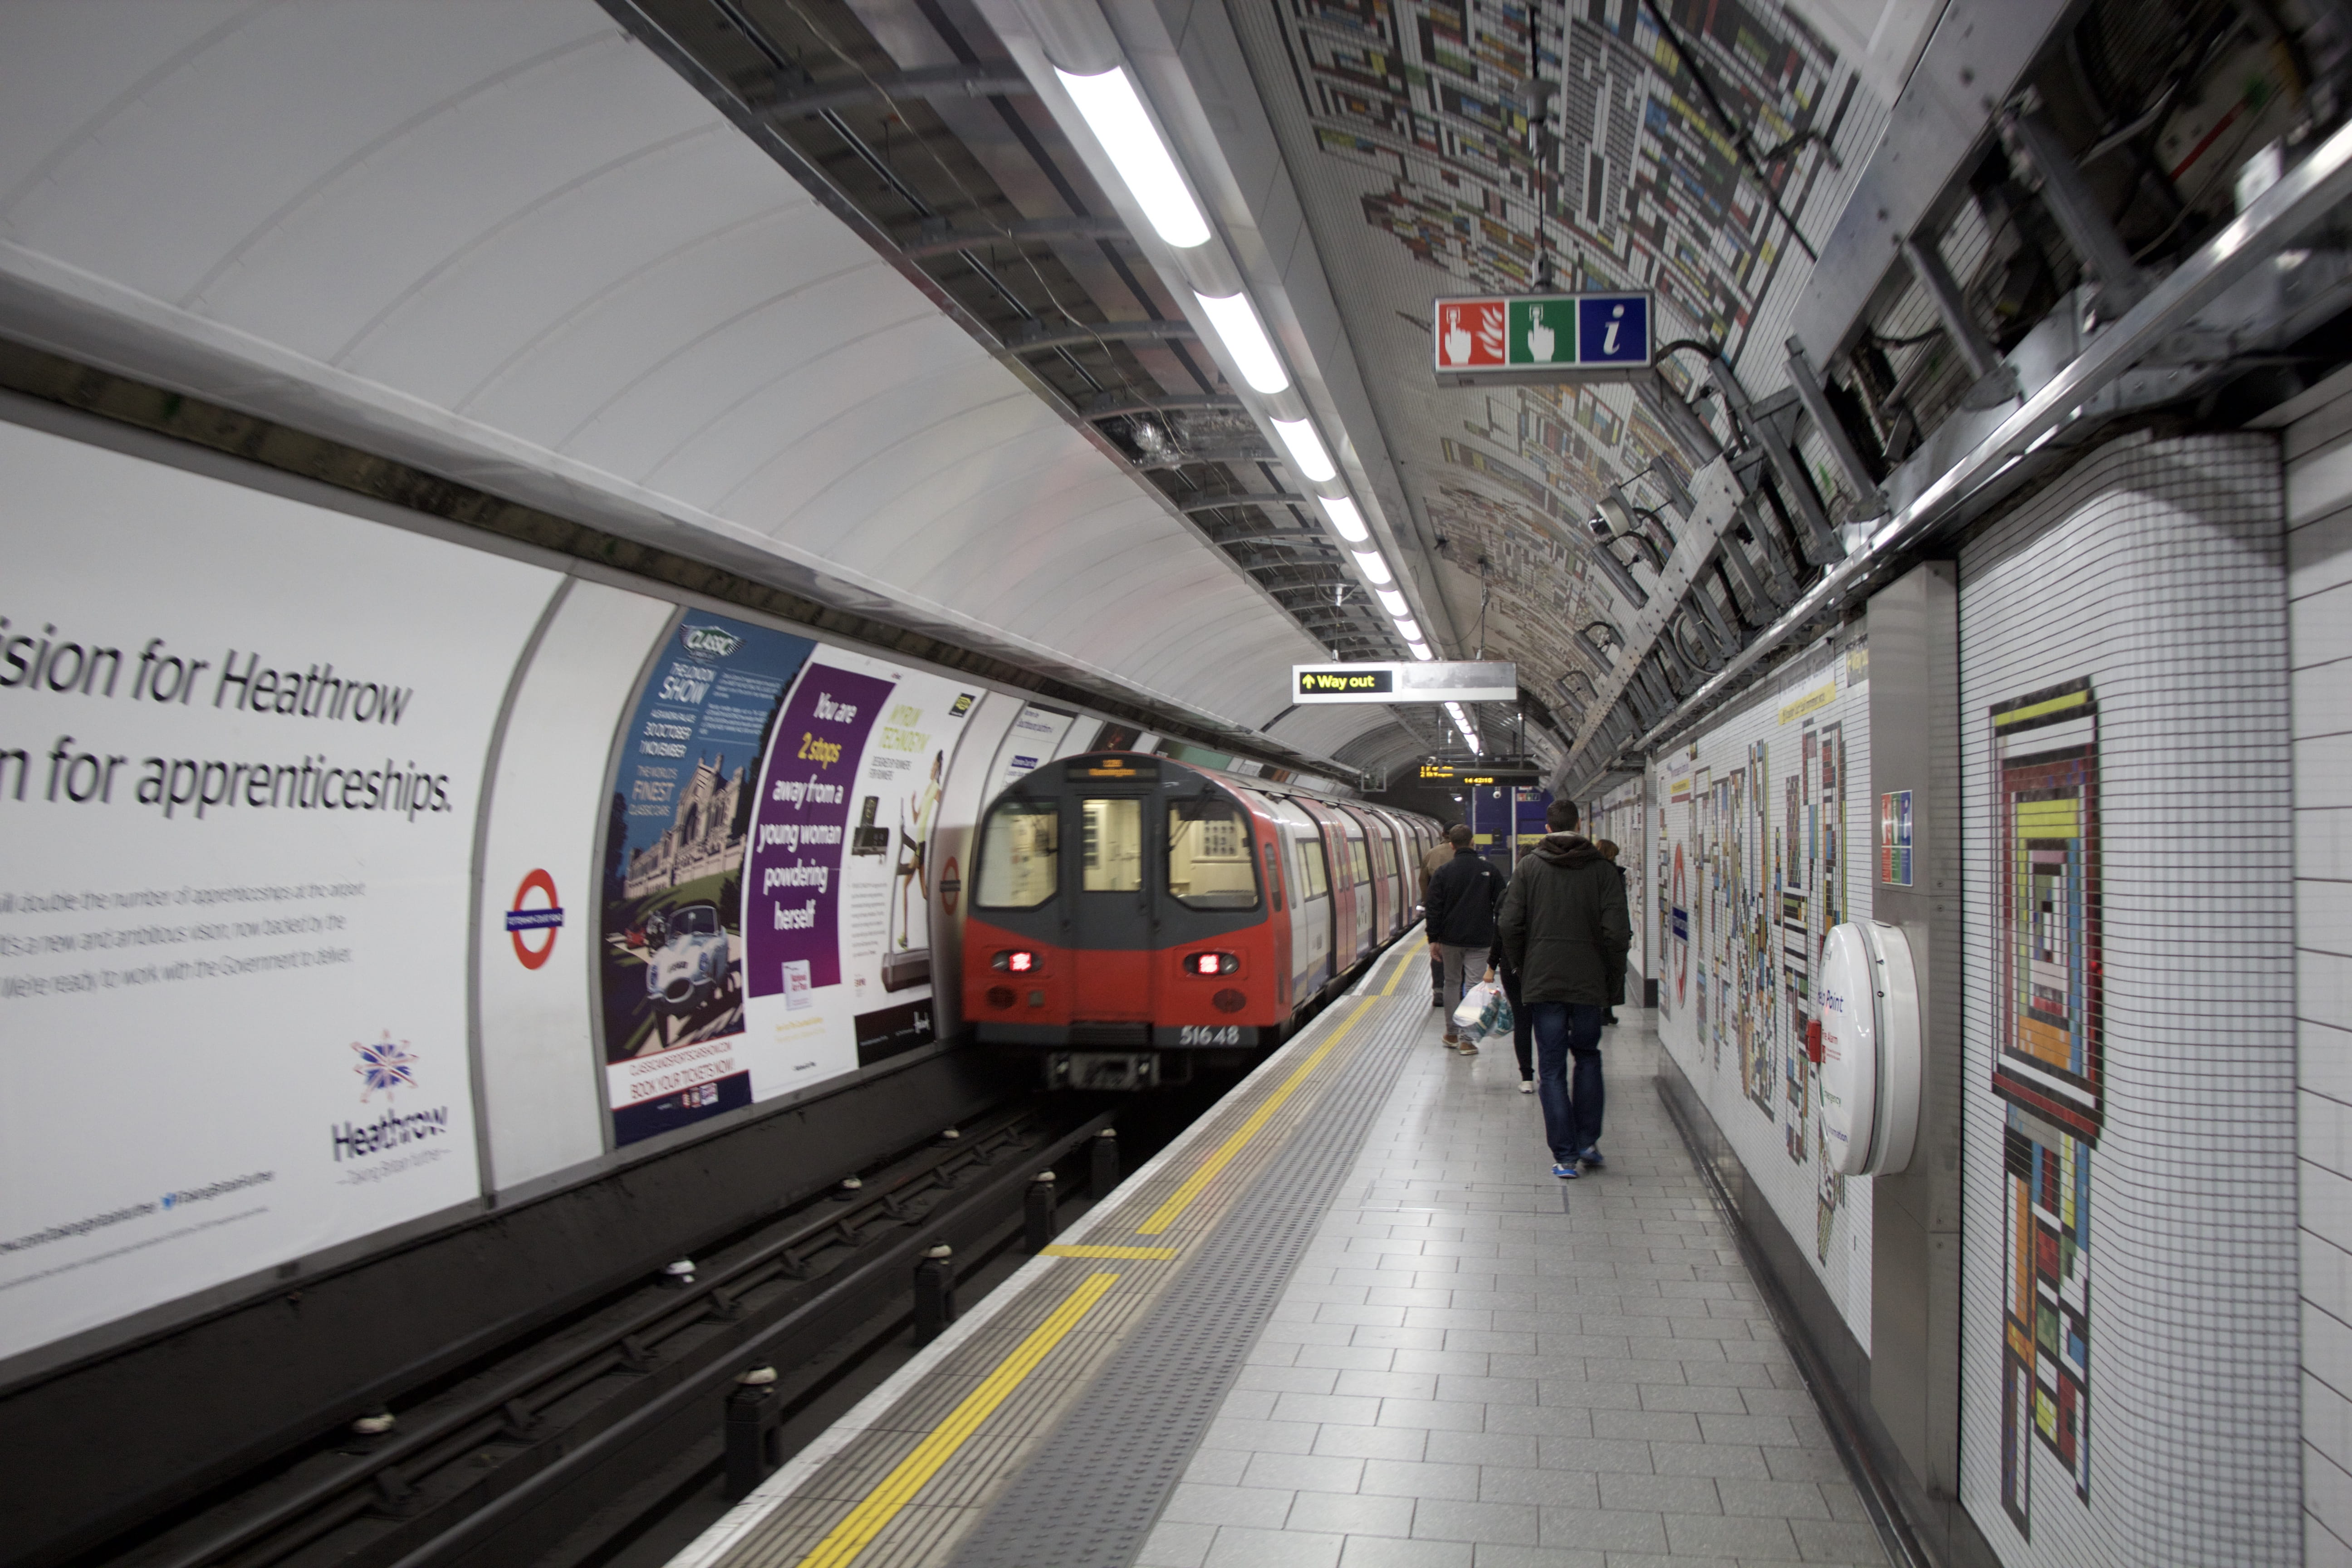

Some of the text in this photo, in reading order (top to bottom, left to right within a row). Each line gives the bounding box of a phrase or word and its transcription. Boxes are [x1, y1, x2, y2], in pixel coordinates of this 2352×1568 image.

[130, 637, 211, 705] for
[212, 649, 413, 725] Heathrow
[658, 676, 710, 704] SHOW
[1317, 675, 1375, 691] Way out
[813, 692, 858, 724] You are
[656, 724, 693, 740] OCTOBER
[644, 741, 687, 758] NOVEMBER
[798, 731, 842, 770] 2 stops
[44, 734, 128, 803] for
[134, 753, 453, 823] apprenticeships.
[632, 780, 675, 802] FINEST
[773, 773, 844, 810] away from a
[756, 823, 842, 853] young woman
[763, 858, 828, 896] powdering
[774, 899, 816, 930] herself
[1825, 989, 1844, 1013] Point
[1179, 1024, 1240, 1045] 51648
[331, 1105, 448, 1162] Heathrow
